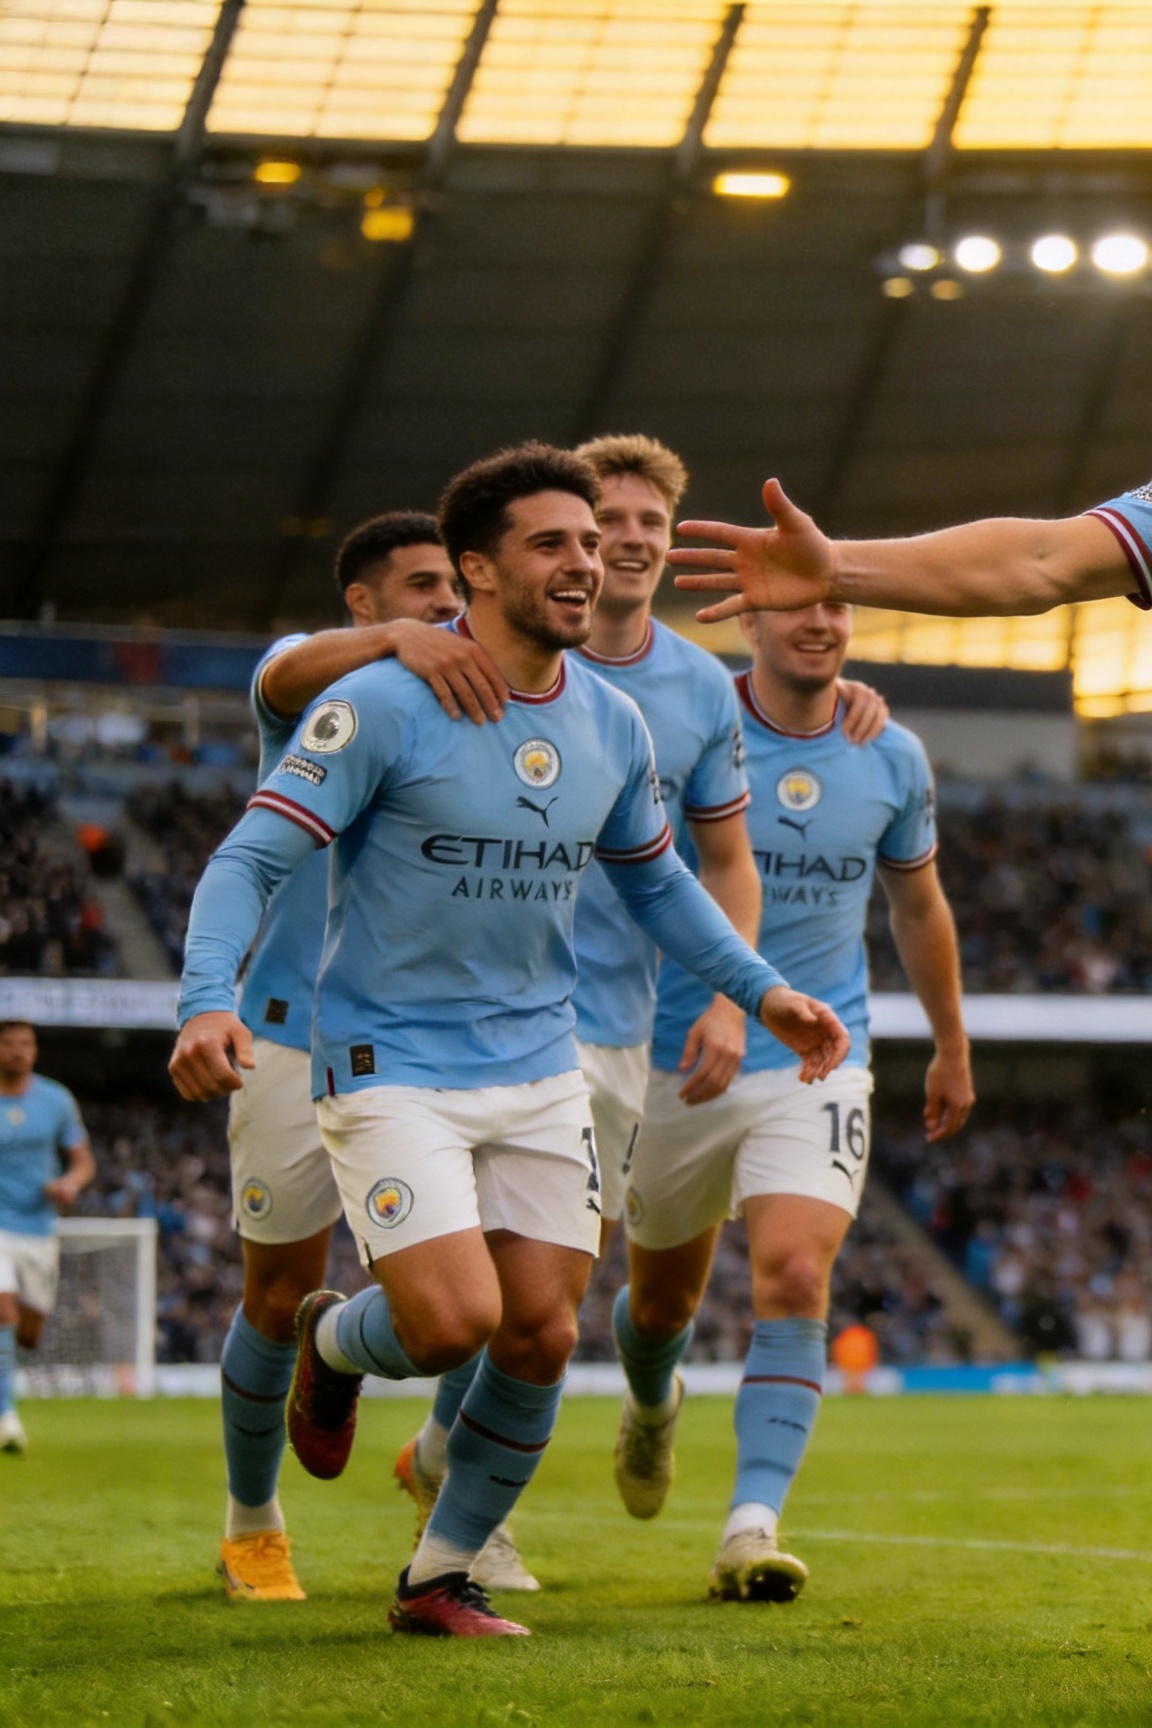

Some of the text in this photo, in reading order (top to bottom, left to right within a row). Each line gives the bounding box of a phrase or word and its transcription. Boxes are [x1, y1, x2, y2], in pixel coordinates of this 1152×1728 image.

[421, 834, 596, 872] ETIHAD
[752, 850, 867, 882] IHAD
[820, 1102, 866, 1161] 16
